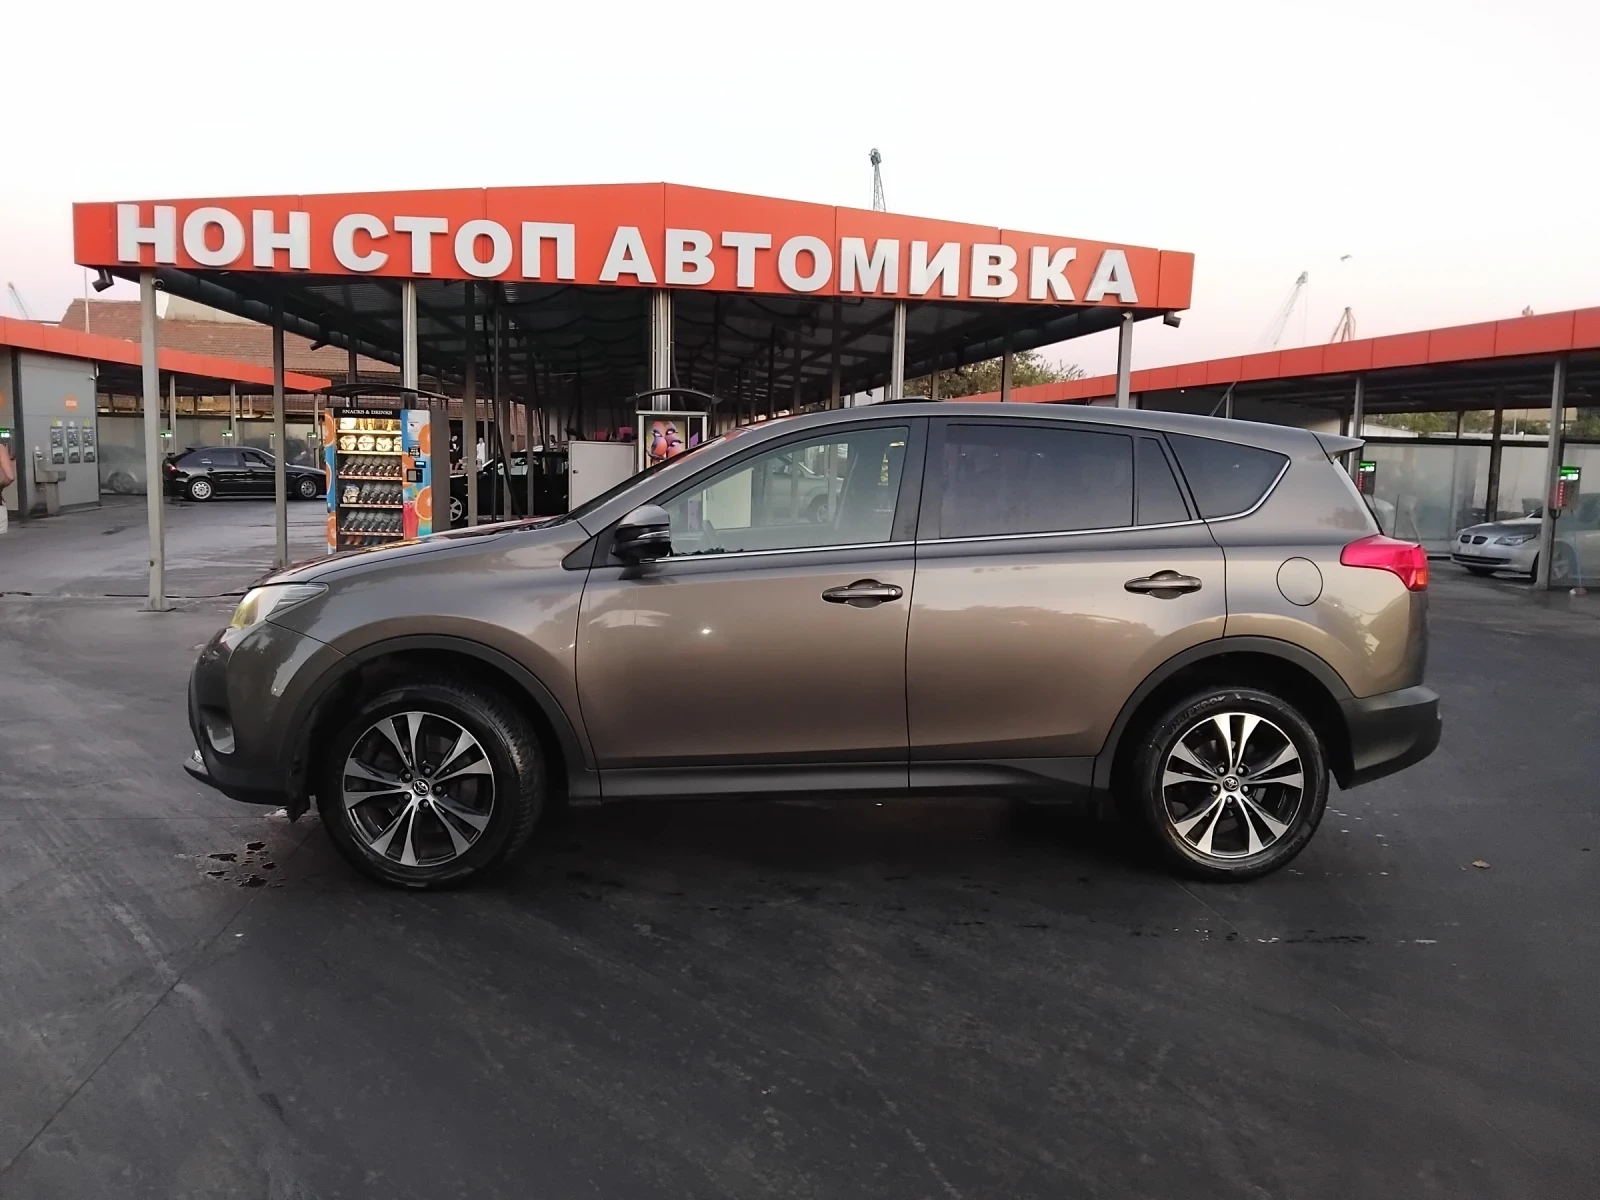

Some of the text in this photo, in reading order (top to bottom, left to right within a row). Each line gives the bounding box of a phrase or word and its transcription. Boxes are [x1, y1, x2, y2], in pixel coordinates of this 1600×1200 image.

[117, 203, 1139, 303] НОН СТОП АВТОМИВКА
